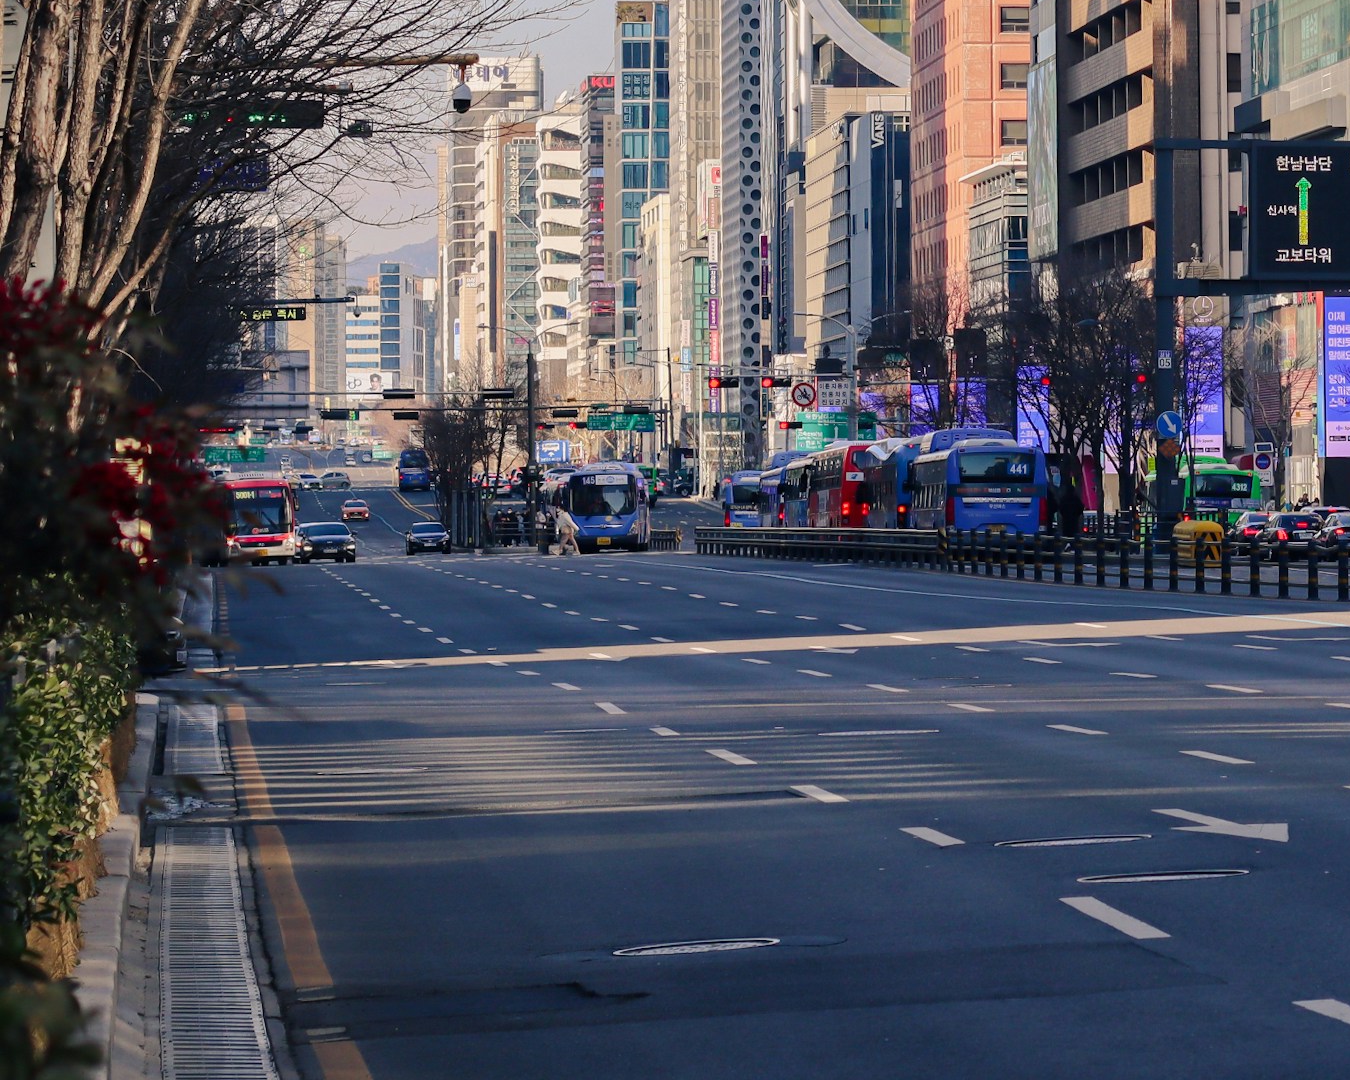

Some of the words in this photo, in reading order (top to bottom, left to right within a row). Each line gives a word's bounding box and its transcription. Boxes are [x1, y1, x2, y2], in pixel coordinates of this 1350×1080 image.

[871, 113, 885, 149] VANS
[1276, 155, 1333, 172] 한남남단
[1267, 205, 1297, 216] 신사역
[1275, 247, 1332, 264] 교보타워
[1328, 311, 1346, 321] 이제
[1159, 357, 1172, 368] 05
[1010, 463, 1027, 475] 441
[582, 476, 595, 486] 145
[1231, 482, 1248, 492] 4312
[236, 490, 255, 500] 5001-1
